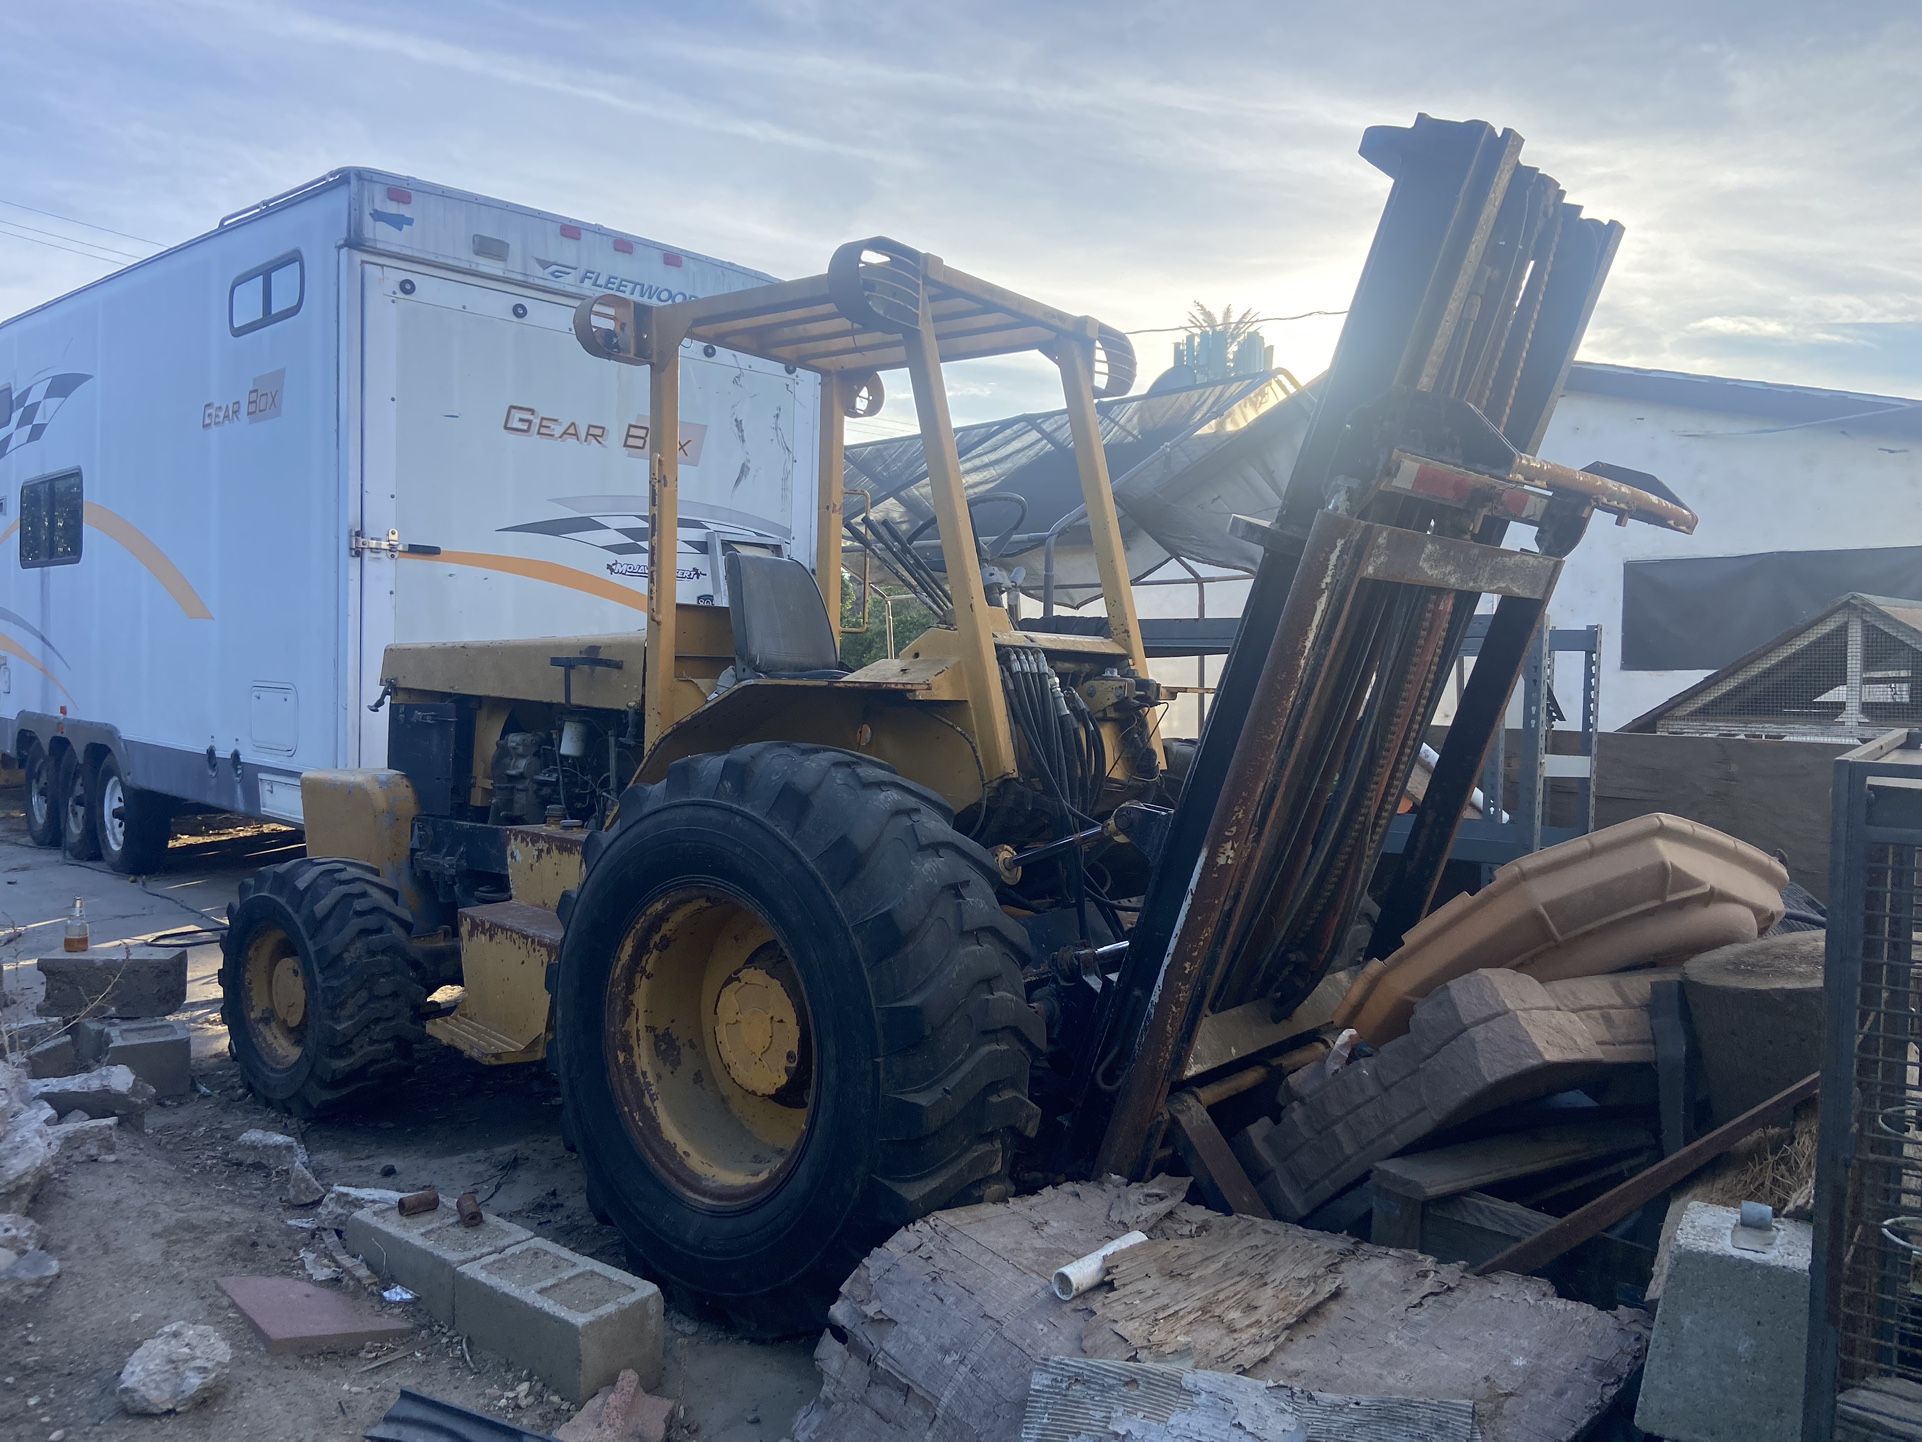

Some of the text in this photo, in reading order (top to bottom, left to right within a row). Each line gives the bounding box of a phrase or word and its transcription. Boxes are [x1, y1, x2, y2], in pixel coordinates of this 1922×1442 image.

[202, 389, 279, 430] GEAR BOX
[503, 404, 692, 457] GEAR BX
[615, 562, 648, 575] MOJAV
